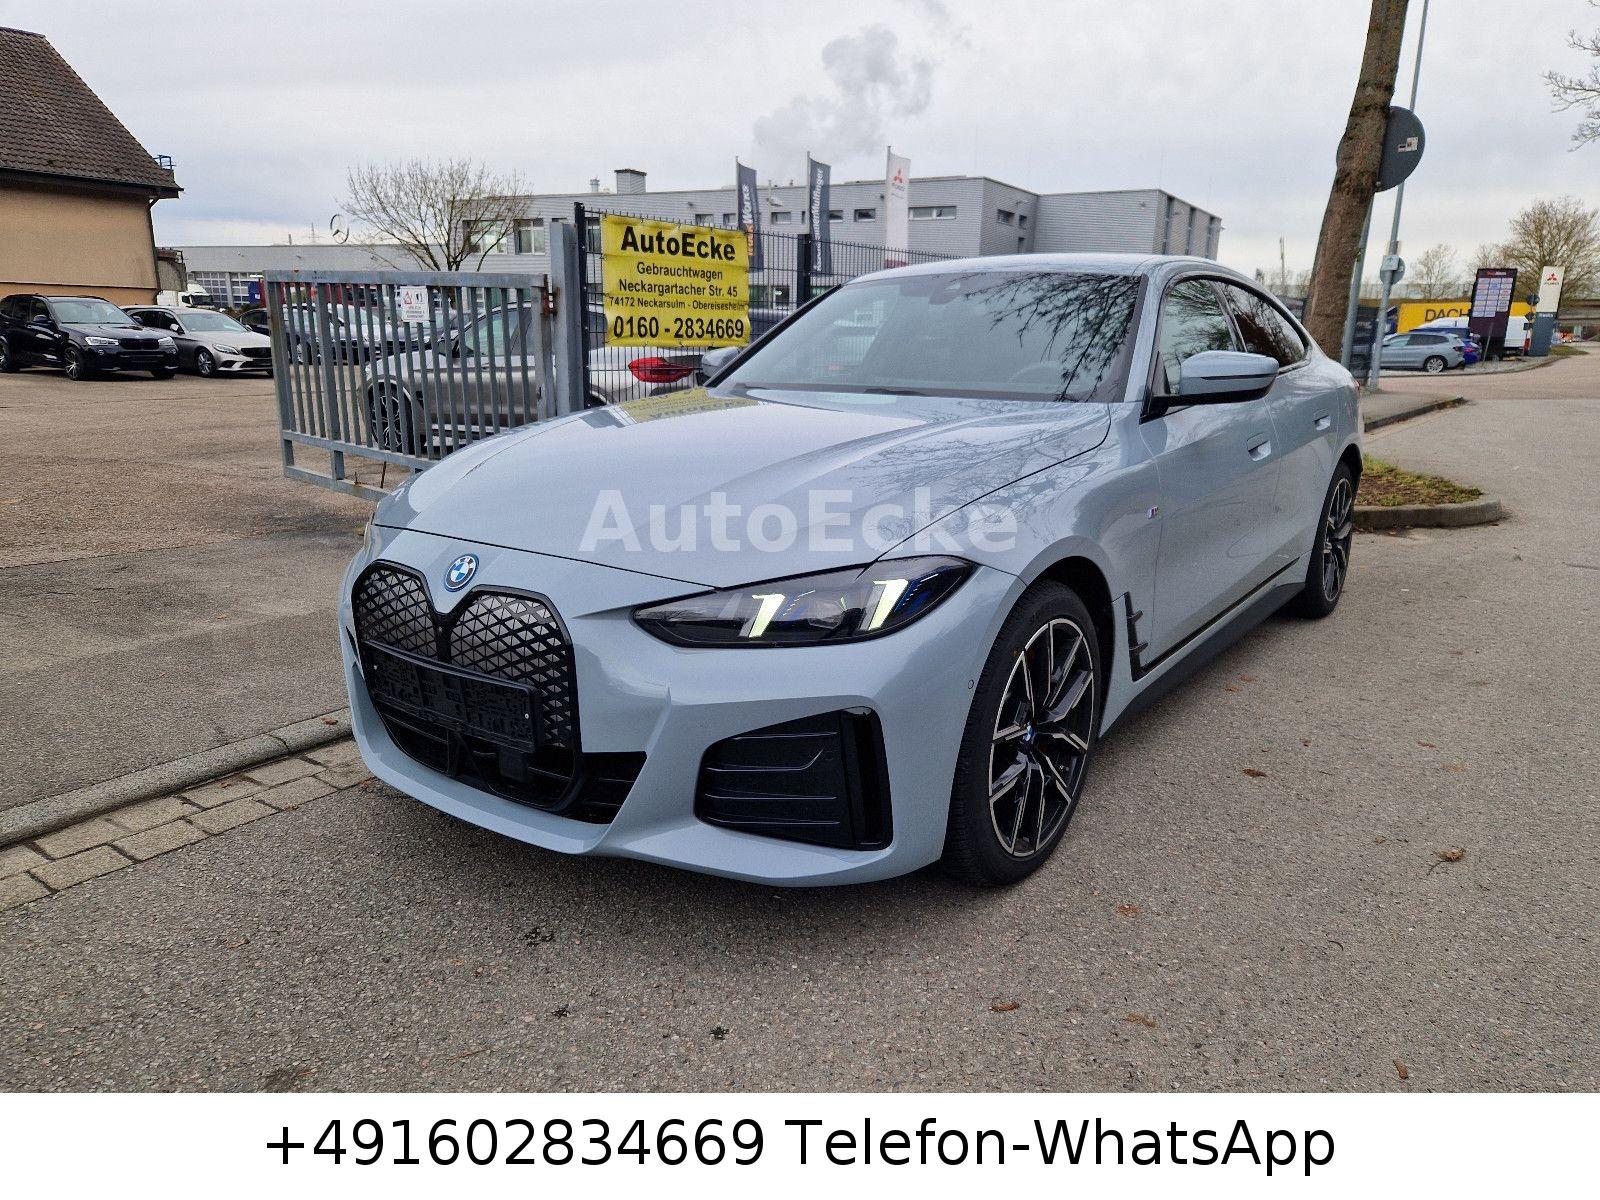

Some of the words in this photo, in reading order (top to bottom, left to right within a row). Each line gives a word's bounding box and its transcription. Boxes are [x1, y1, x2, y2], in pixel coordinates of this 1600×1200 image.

[620, 225, 736, 261] AutoEcke
[637, 261, 723, 282] Gebrauchtwagen
[619, 278, 705, 296] Neckargartacher
[708, 284, 724, 297] Str.
[727, 286, 738, 298] 45
[609, 296, 635, 308] 74172
[637, 297, 686, 309] Neckarsulm
[613, 315, 659, 339] 0160
[674, 316, 744, 339] 2834669
